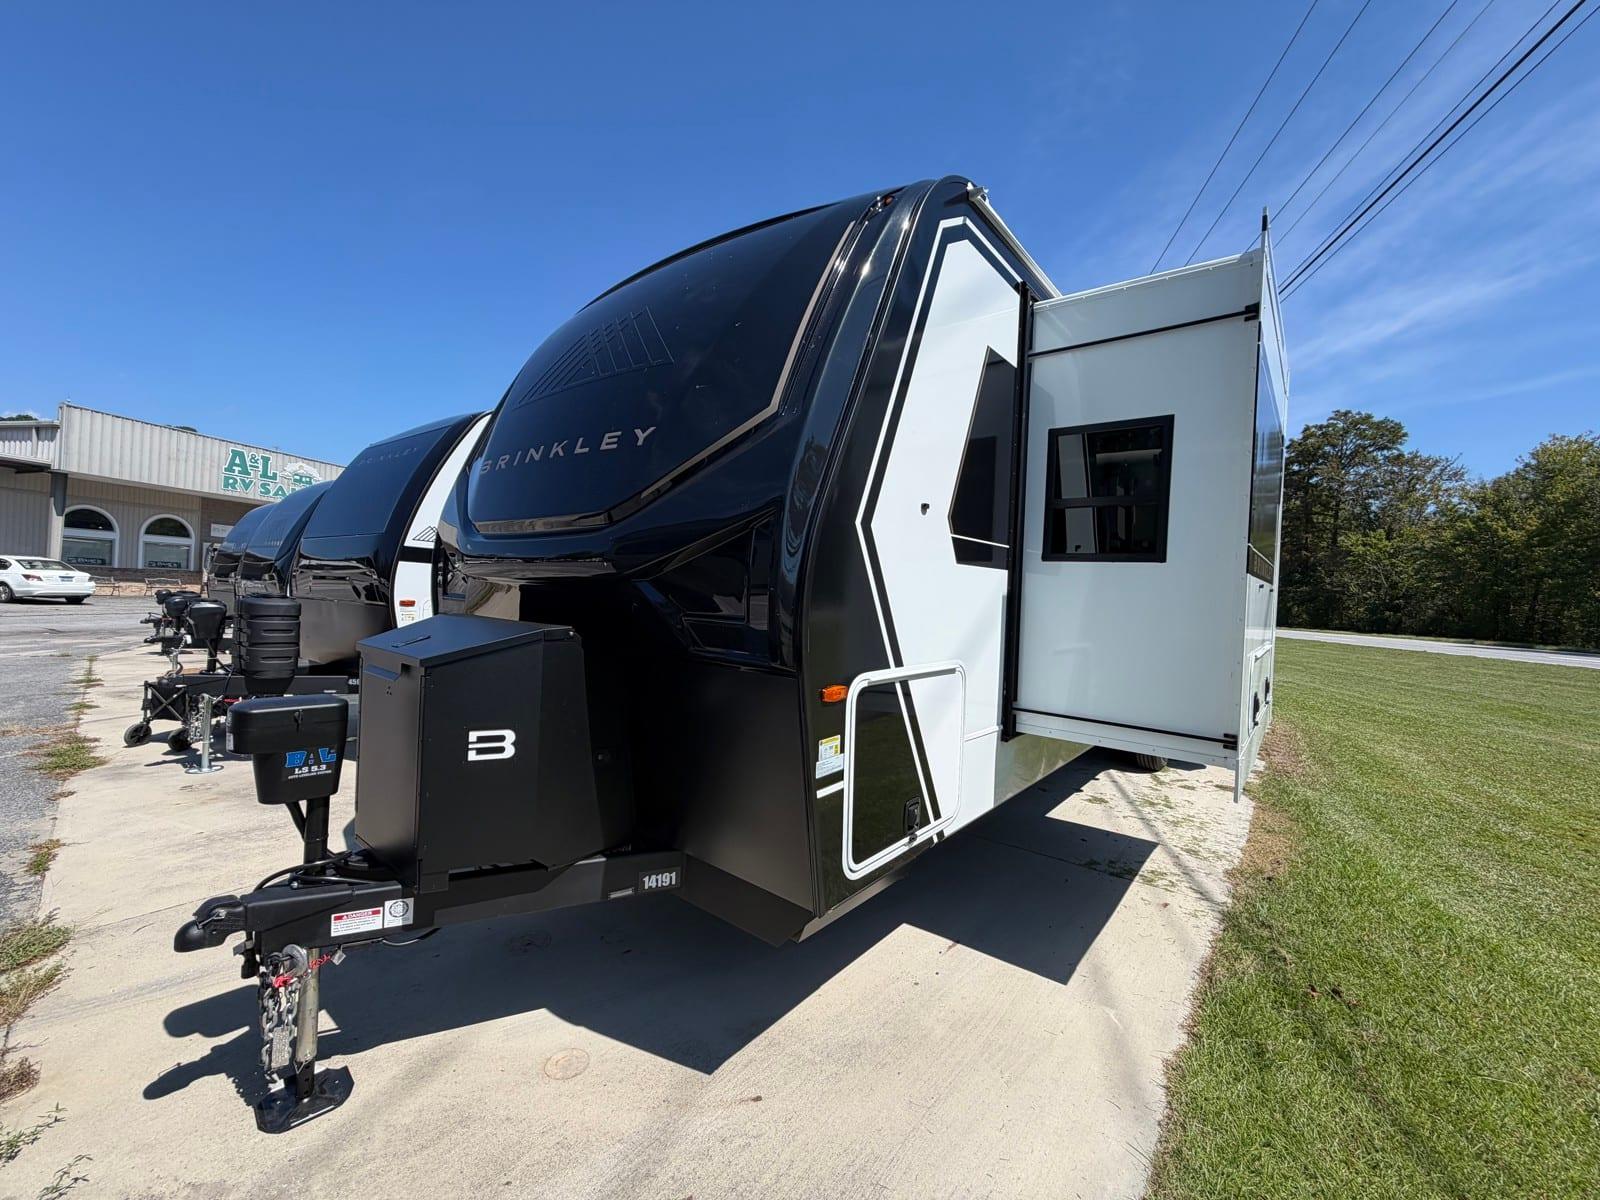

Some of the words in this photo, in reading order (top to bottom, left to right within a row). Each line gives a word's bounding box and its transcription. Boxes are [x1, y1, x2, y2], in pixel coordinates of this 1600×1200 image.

[480, 427, 656, 474] BRINKLEY
[224, 448, 278, 481] A&L
[223, 475, 255, 492] RV
[294, 766, 309, 774] LS
[643, 872, 676, 889] 14191
[348, 911, 373, 920] DANGER
